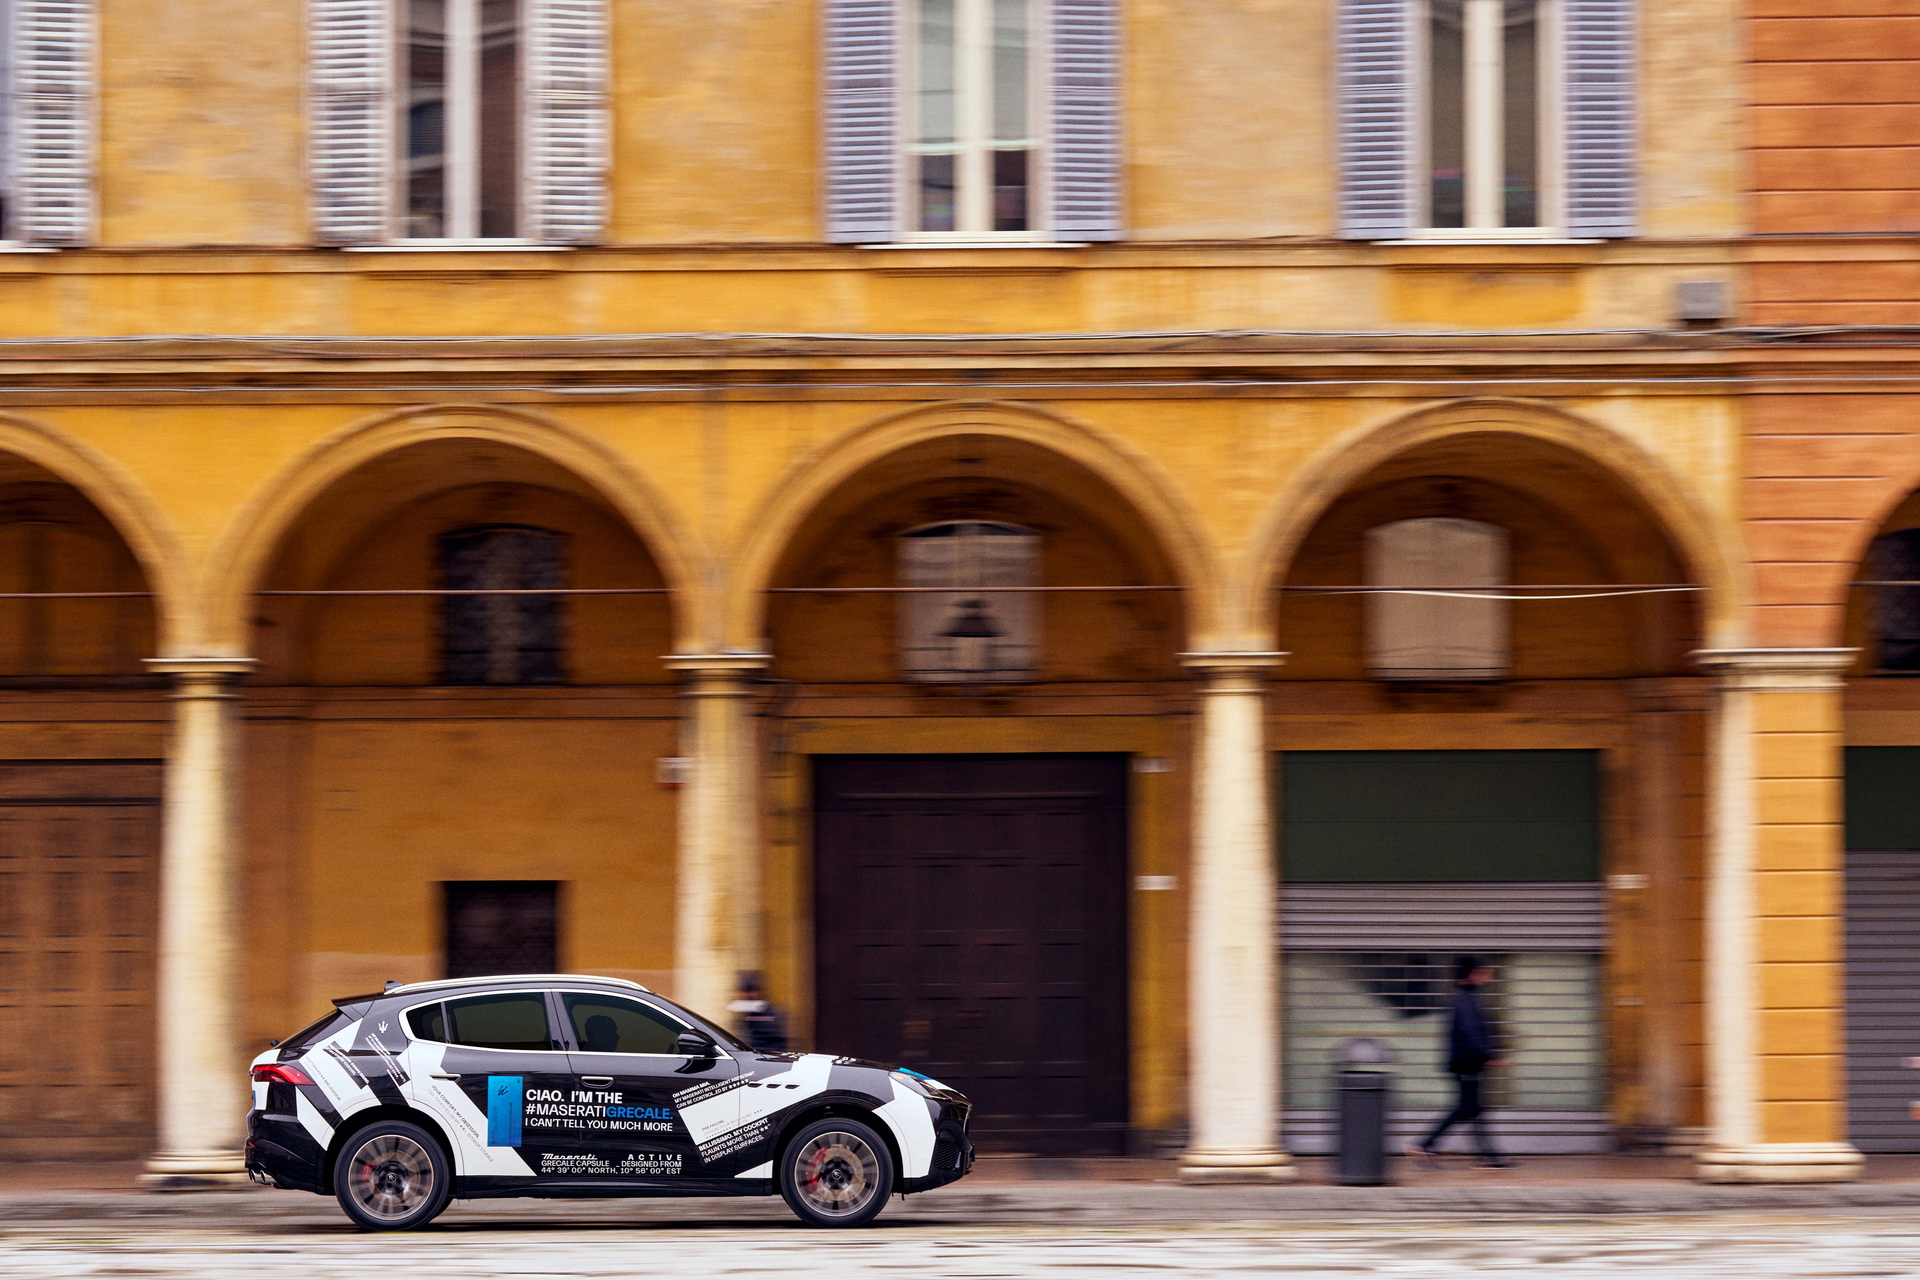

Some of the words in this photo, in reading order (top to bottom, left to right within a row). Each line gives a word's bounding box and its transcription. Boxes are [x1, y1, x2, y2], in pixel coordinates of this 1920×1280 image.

[431, 1084, 441, 1095] YOUR
[526, 1089, 564, 1102] CIAO.
[571, 1091, 593, 1103] I'M
[596, 1092, 623, 1104] THE
[679, 1084, 700, 1095] MAMMA
[681, 1088, 704, 1100] MASERATI
[703, 1078, 731, 1092] INTELLIGENT
[525, 1118, 528, 1126] I
[531, 1118, 561, 1127] CAN'T
[562, 1119, 585, 1128] TELL
[587, 1120, 607, 1129] YOU
[610, 1121, 641, 1130] MUCH
[643, 1122, 673, 1131] MORE
[698, 1132, 733, 1151] BELLISSIMO.
[732, 1127, 743, 1136] MY
[742, 1117, 768, 1132] COCKPIT
[700, 1142, 726, 1157] FLAUNTS
[726, 1135, 743, 1146] MORE
[743, 1128, 759, 1139] THAN
[710, 1146, 734, 1161] DISPLAY
[733, 1133, 764, 1151] SURFACES.
